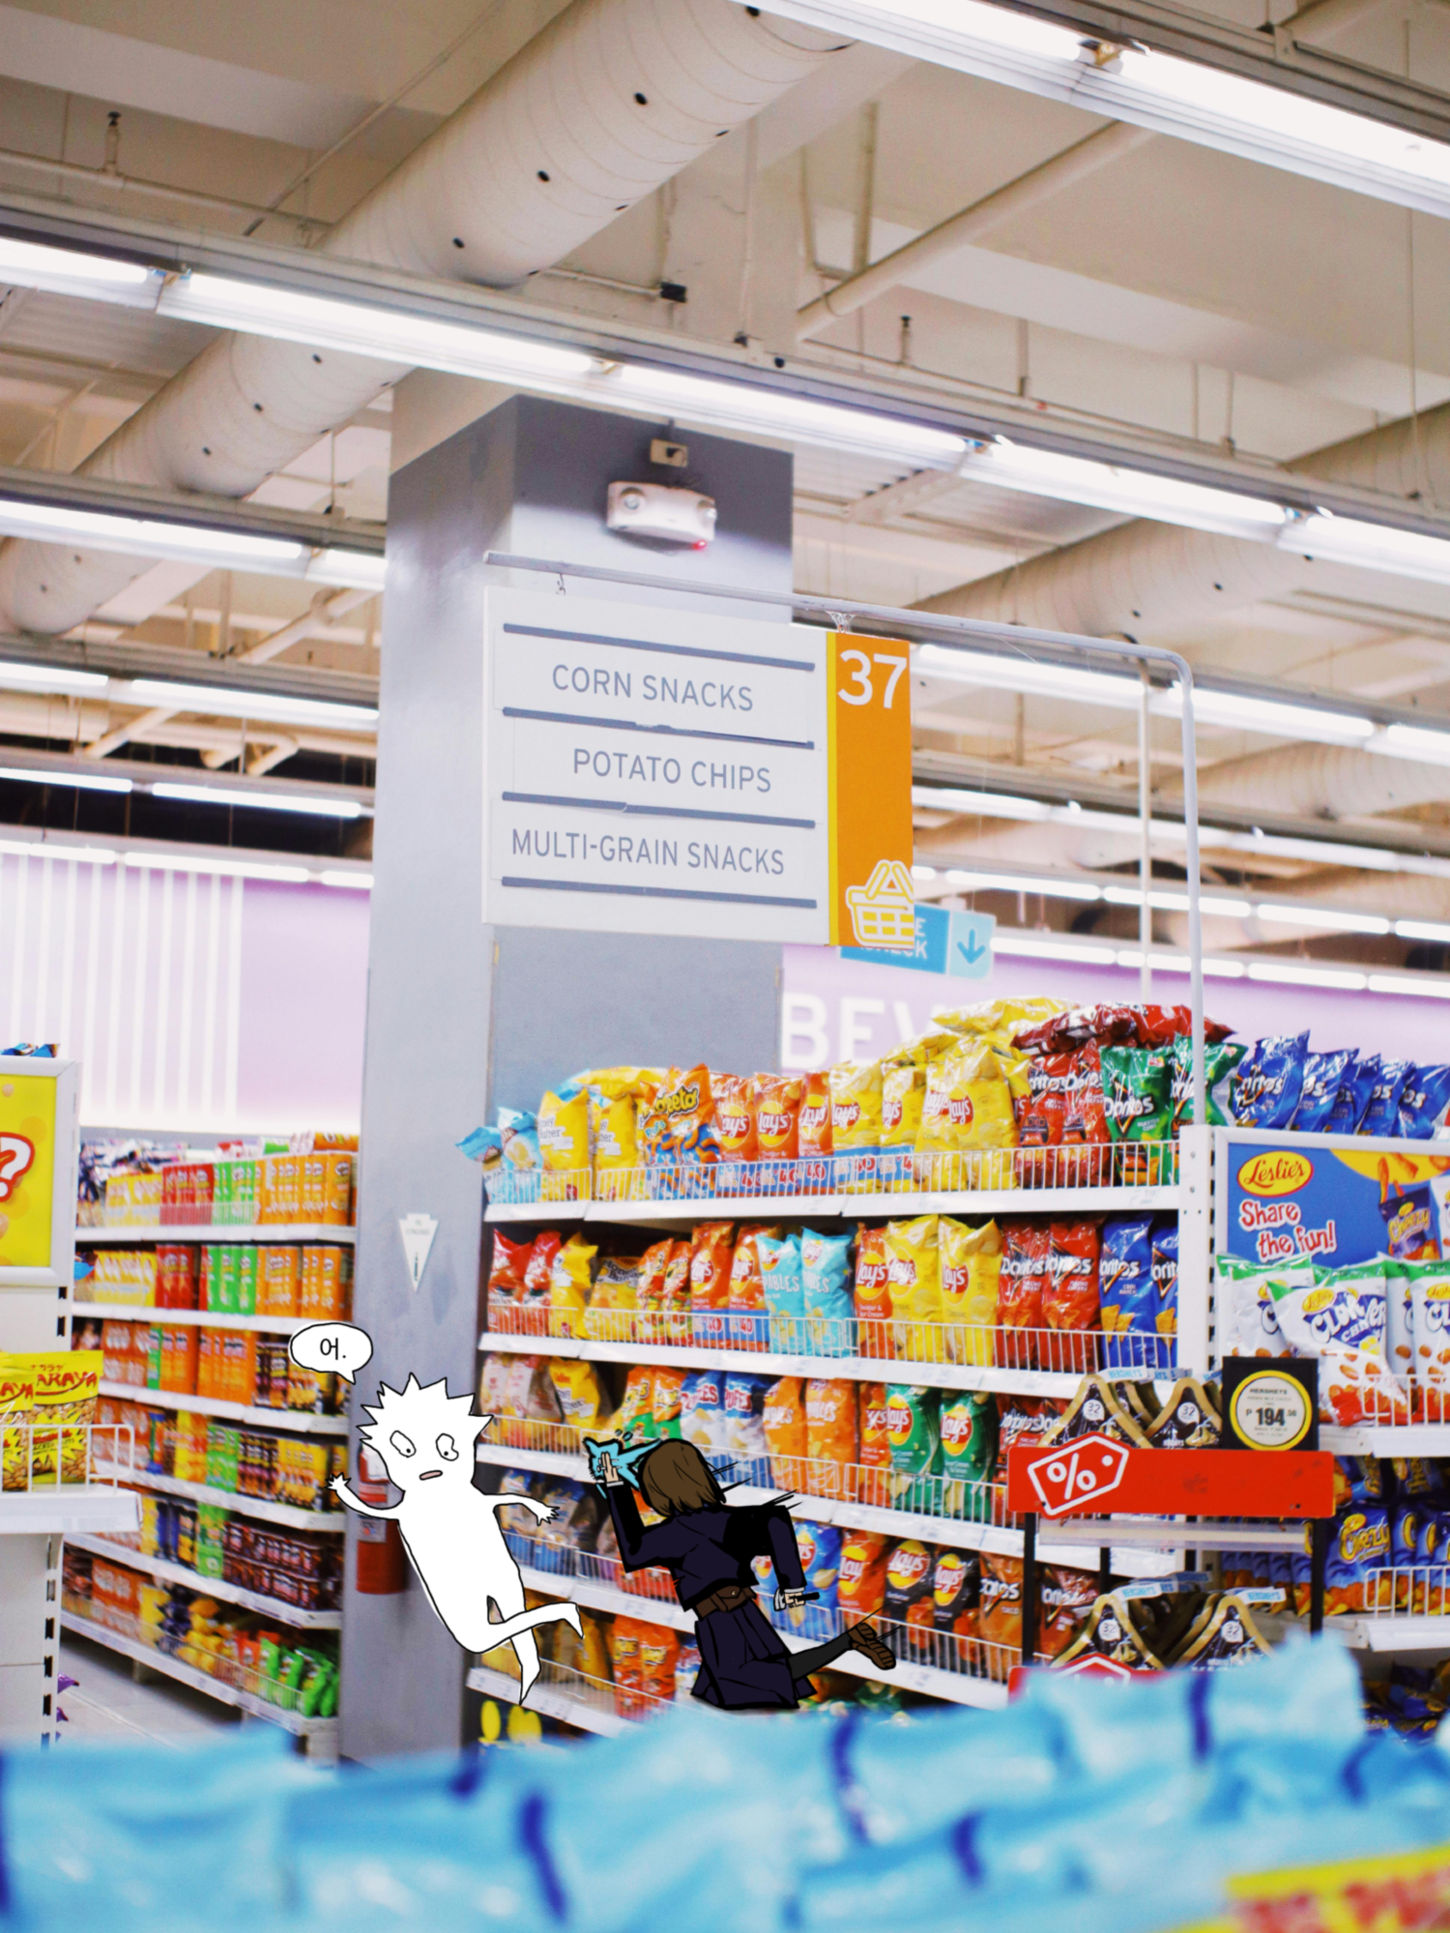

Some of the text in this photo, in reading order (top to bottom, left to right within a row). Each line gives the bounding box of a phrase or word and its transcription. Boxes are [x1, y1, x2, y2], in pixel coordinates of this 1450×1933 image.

[552, 664, 753, 711] CORN SNACKS
[837, 649, 907, 709] 37
[574, 748, 772, 793] POTATO CHIPS
[511, 828, 784, 875] MULTI-GRAIN SNACKS
[1244, 1158, 1305, 1188] Leslie's
[1240, 1200, 1300, 1228] Share
[1258, 1221, 1335, 1258] the fun!
[857, 1262, 886, 1288] Lay's
[1182, 1405, 1196, 1417] 32
[1256, 1406, 1286, 1427] 194
[888, 1550, 925, 1577] Lay's
